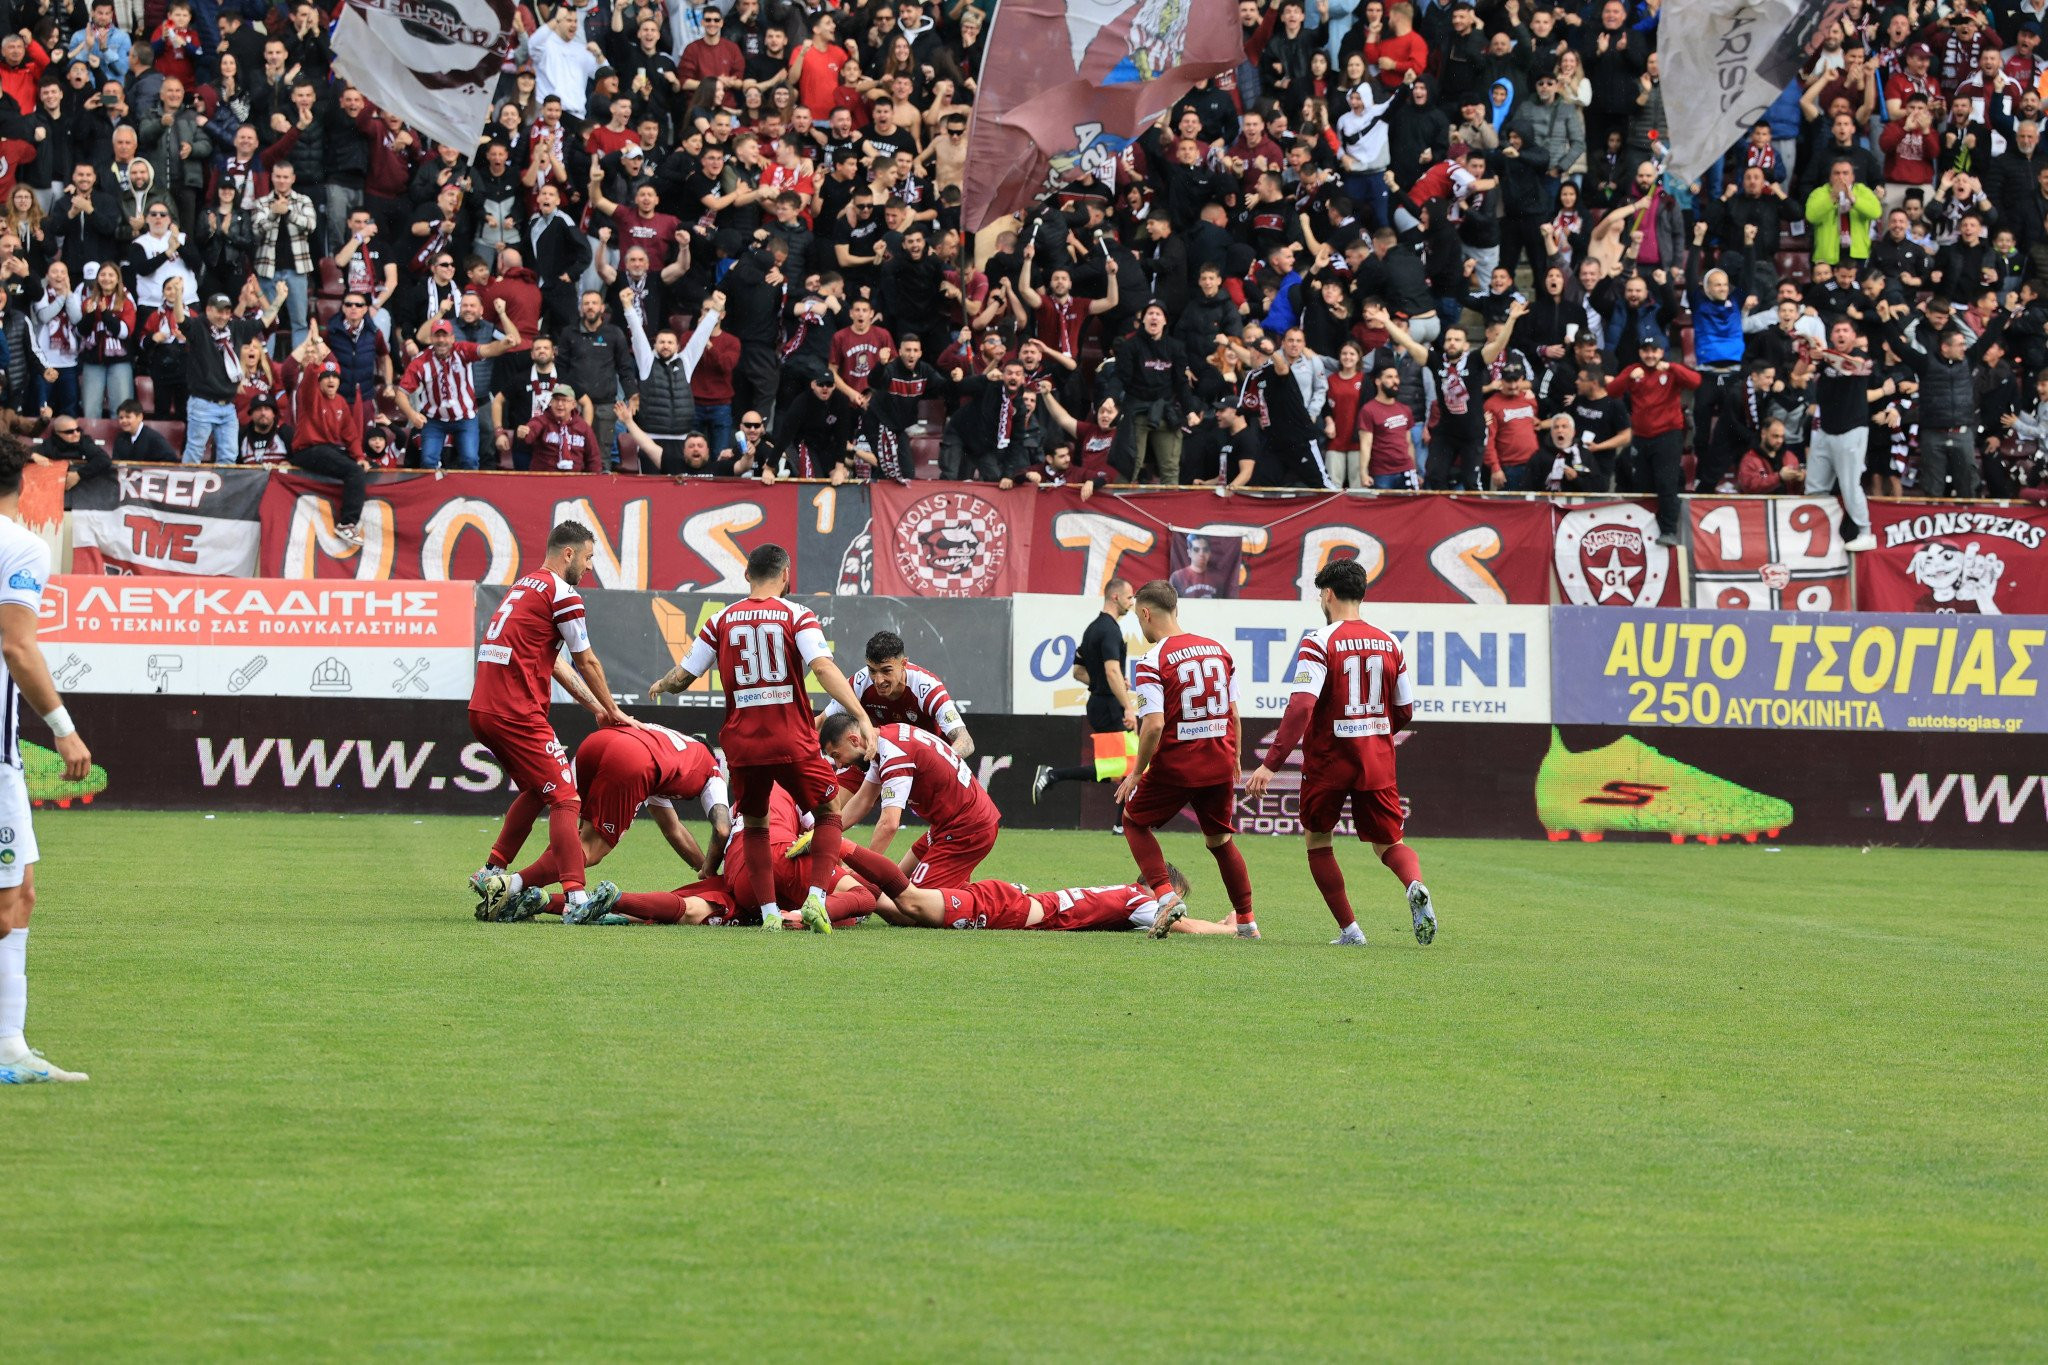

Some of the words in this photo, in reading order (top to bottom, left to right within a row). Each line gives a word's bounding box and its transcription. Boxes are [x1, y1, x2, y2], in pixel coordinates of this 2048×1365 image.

[117, 467, 222, 508] KEEP
[897, 494, 1007, 542] MONSTERS
[1884, 511, 2047, 550] MONSTERS
[1581, 529, 1642, 557] MONSTERS
[896, 551, 930, 591] KEEP
[1604, 569, 1627, 587] G1
[76, 586, 439, 617] ΛΕΥΚΑΔΙΤΗΣ
[486, 589, 526, 641] 5
[725, 609, 789, 624] MOUTINHO
[75, 616, 102, 631] ΤΟ
[110, 617, 201, 633] ΤΕΧΝΙΚΟ
[210, 619, 249, 634] ΣΑΣ
[259, 620, 438, 635] ΠΟΛΥΚΑΤΑΣΤΗΜΑ
[728, 622, 788, 685] 30
[1166, 645, 1223, 665] OIKONOMOU
[1334, 639, 1394, 652] MOURGOS
[1603, 621, 1747, 680] AUTO
[1769, 624, 2047, 697] ΤΣΟΓΙΑΣ
[1176, 656, 1230, 721] 23
[1343, 654, 1385, 716] 11
[1256, 697, 1289, 710] SUP
[1412, 700, 1445, 713] PER
[1452, 700, 1506, 714] ΓΕΥΣΗ
[1627, 681, 1721, 725] 250
[1723, 697, 1885, 729] ΑΥΤΟΚΙΝΗΤΑ
[1906, 715, 2024, 733] autotsogias.gr
[1336, 722, 1391, 734] Aegeanollege
[1879, 772, 2048, 824] ww
